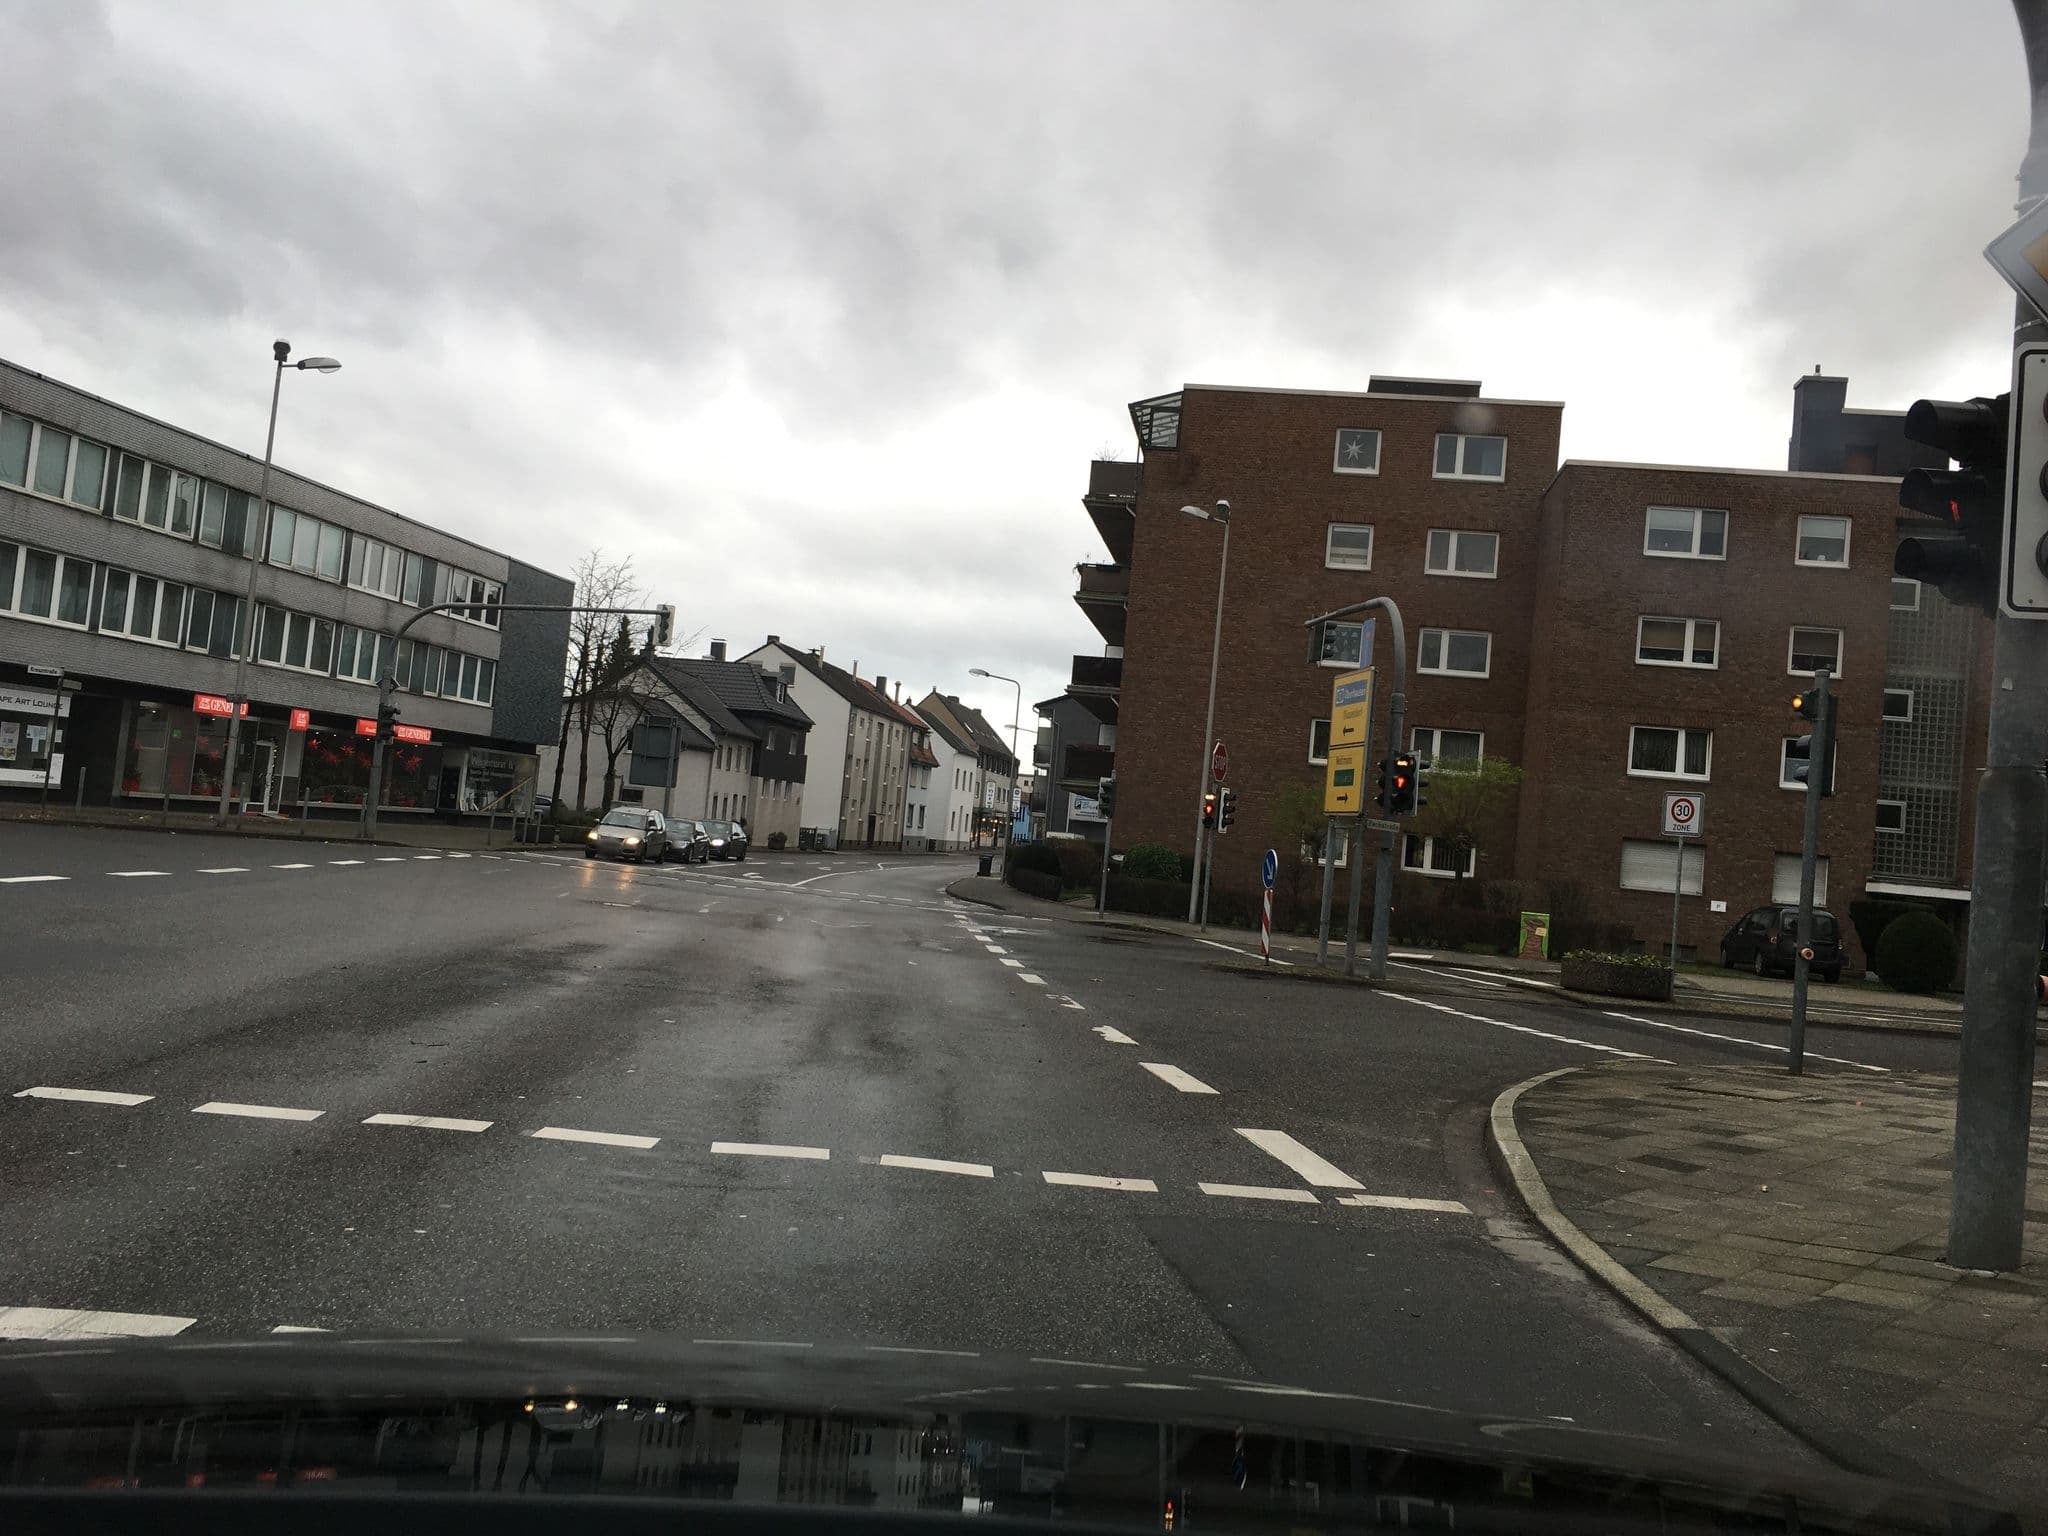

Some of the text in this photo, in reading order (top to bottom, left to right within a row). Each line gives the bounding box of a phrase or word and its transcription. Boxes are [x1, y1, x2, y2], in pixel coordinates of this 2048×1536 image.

[1214, 754, 1226, 770] STOP
[1675, 804, 1690, 817] 30
[1672, 823, 1691, 832] ZONE
